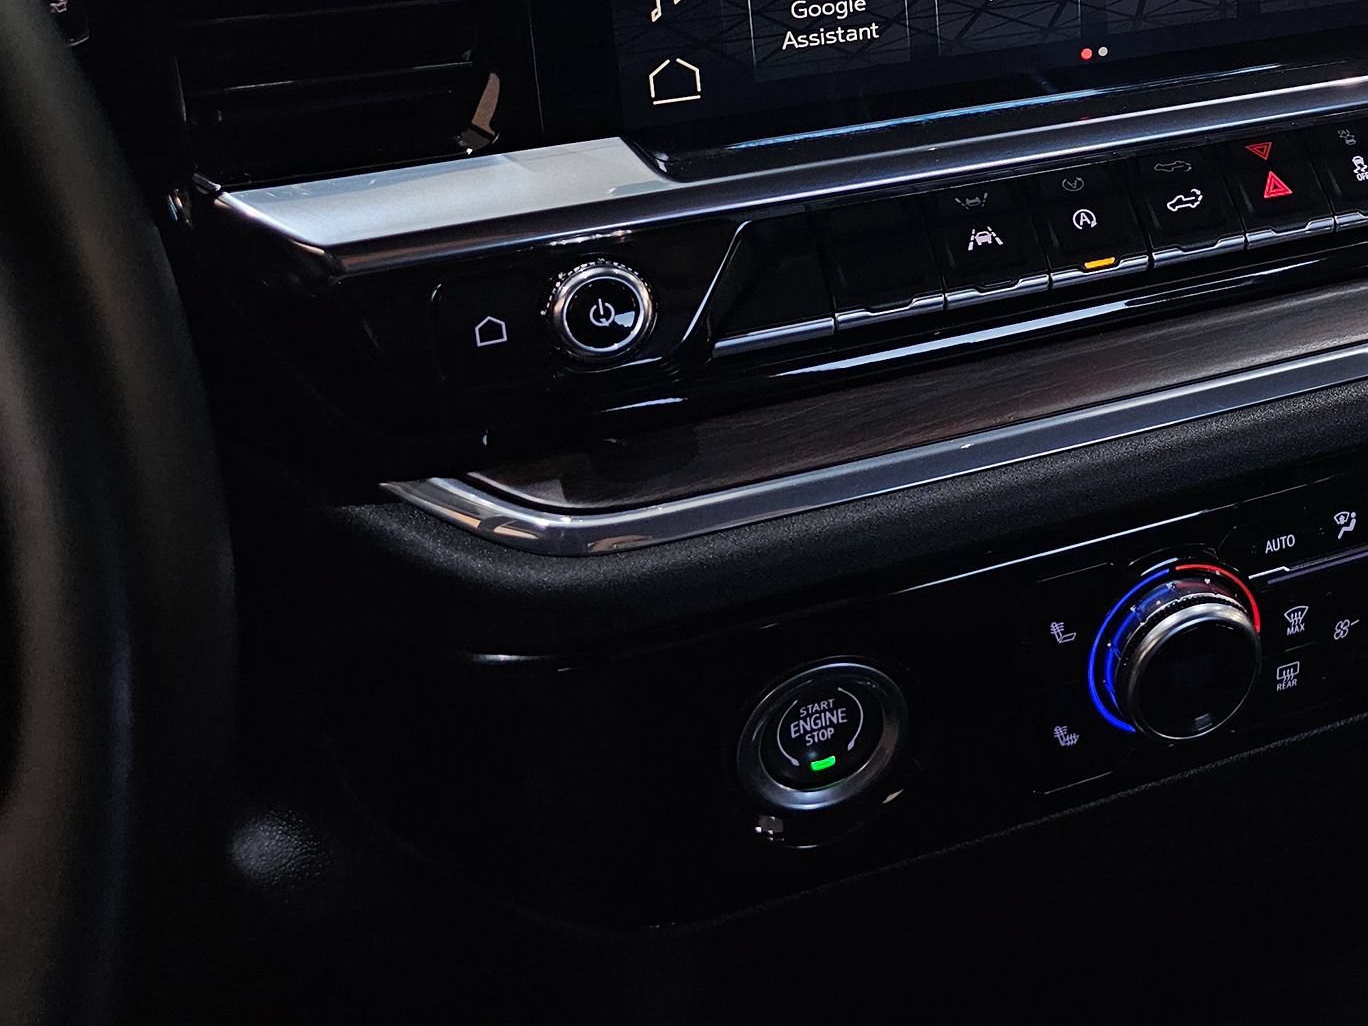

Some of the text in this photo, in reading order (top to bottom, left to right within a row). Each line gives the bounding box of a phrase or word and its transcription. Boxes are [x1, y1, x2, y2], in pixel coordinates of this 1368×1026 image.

[782, 22, 880, 51] Assistant
[1265, 533, 1296, 554] AUTO
[1286, 622, 1306, 637] MAX
[1276, 677, 1299, 692] REAR
[799, 698, 836, 718] START
[789, 707, 848, 739] ENGINE
[805, 727, 835, 747] STOP
